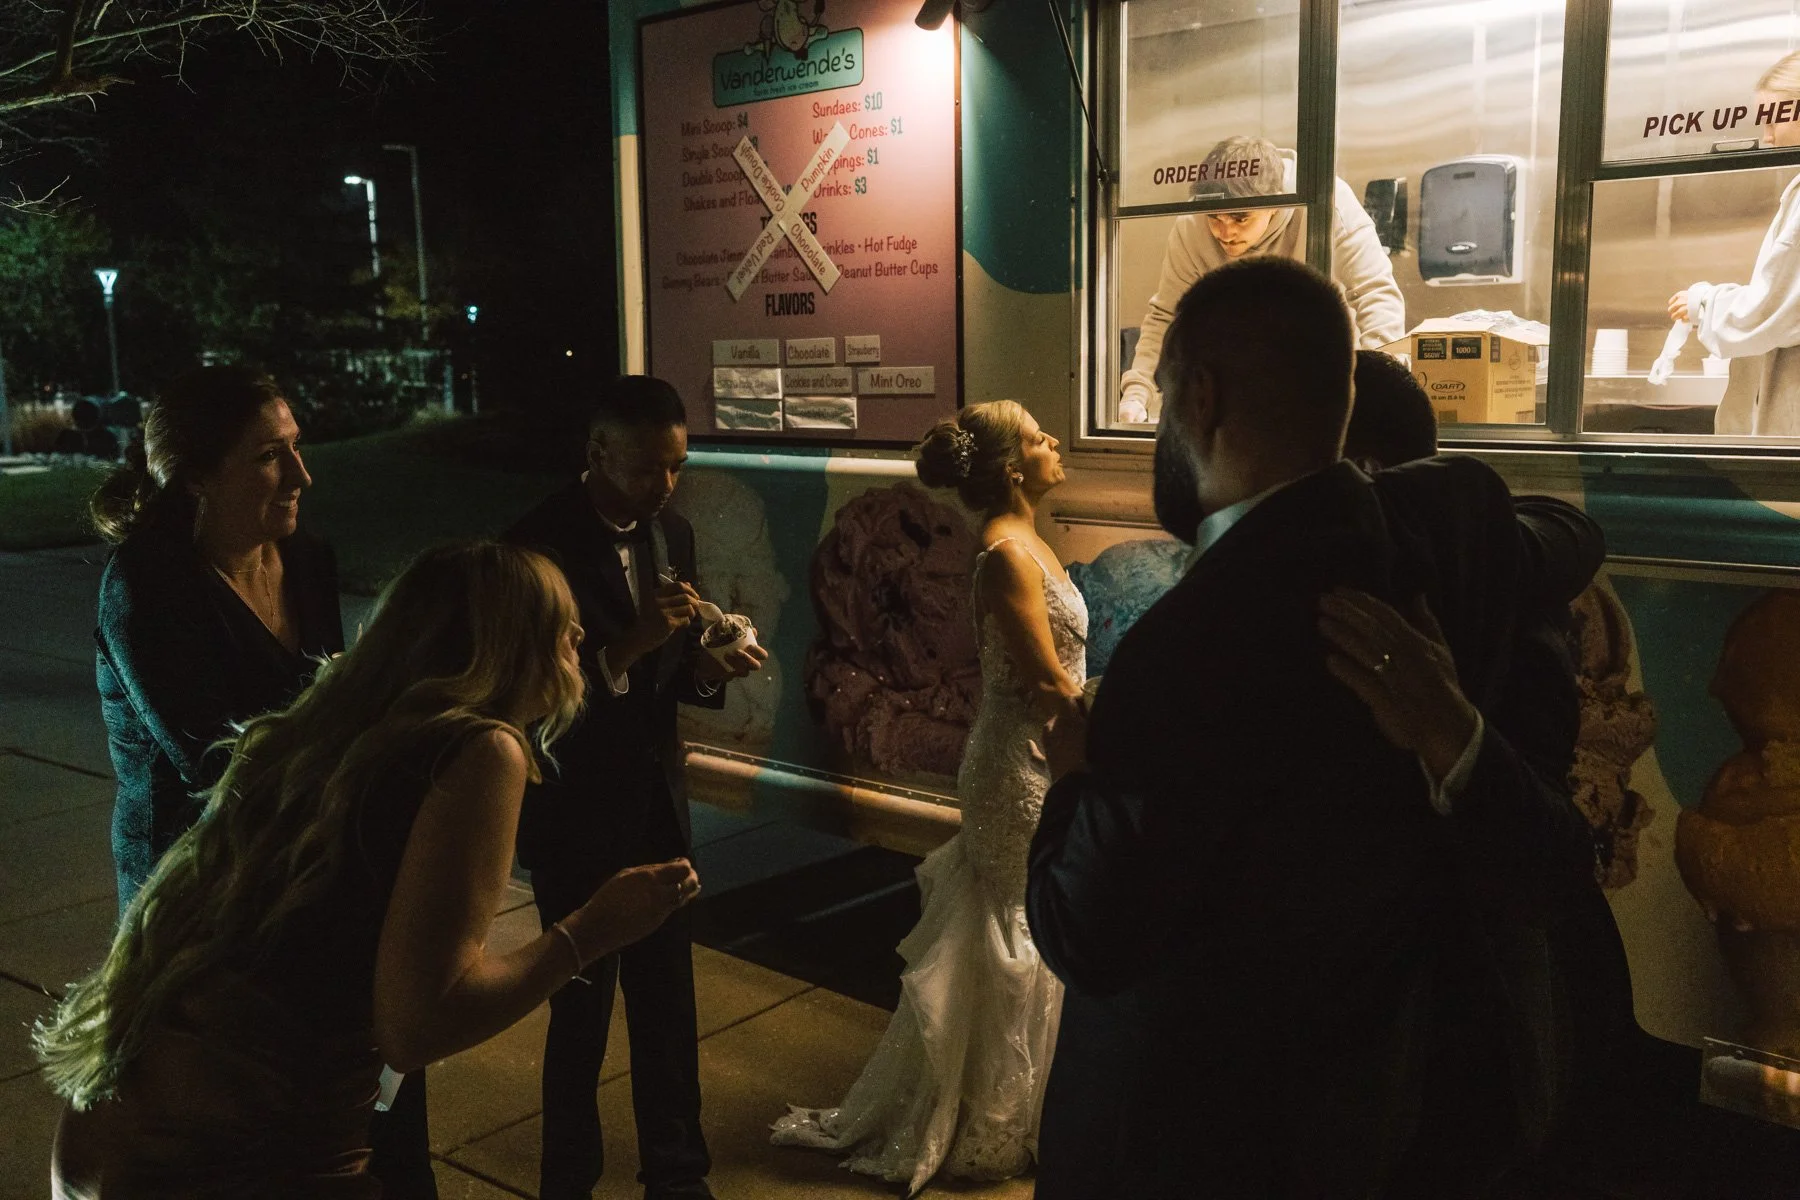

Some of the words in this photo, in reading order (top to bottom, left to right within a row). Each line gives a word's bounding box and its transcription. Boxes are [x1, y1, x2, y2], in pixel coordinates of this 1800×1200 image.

[812, 99, 862, 119] Sundaes:
[864, 91, 884, 112] $10
[703, 118, 736, 137] Scoop:
[737, 111, 748, 129] $4
[849, 123, 889, 140] Cones:
[890, 116, 903, 137] $1
[1643, 110, 1705, 138] PICK
[1712, 105, 1748, 131] UP
[867, 146, 880, 166] $1
[800, 147, 835, 192] Pumpkin
[1153, 163, 1209, 186] ORDER
[1214, 158, 1260, 180] HERE
[761, 175, 785, 212] Cookie
[854, 176, 867, 195] $3
[719, 191, 737, 208] and
[756, 231, 775, 257] Red
[790, 223, 826, 277] Chocolate
[822, 239, 855, 257] rinkles
[864, 236, 884, 253] Hot
[886, 235, 918, 255] Fudge
[761, 267, 790, 284] Butter
[875, 261, 909, 277] Butter
[910, 259, 939, 280] Cups
[765, 292, 815, 316] FLAVORS
[730, 344, 761, 360] Vanilla
[787, 344, 831, 361] Chocolate
[784, 373, 810, 390] Cookies
[811, 373, 826, 389] and
[870, 374, 893, 389] Mint
[897, 373, 922, 389] Oreo
